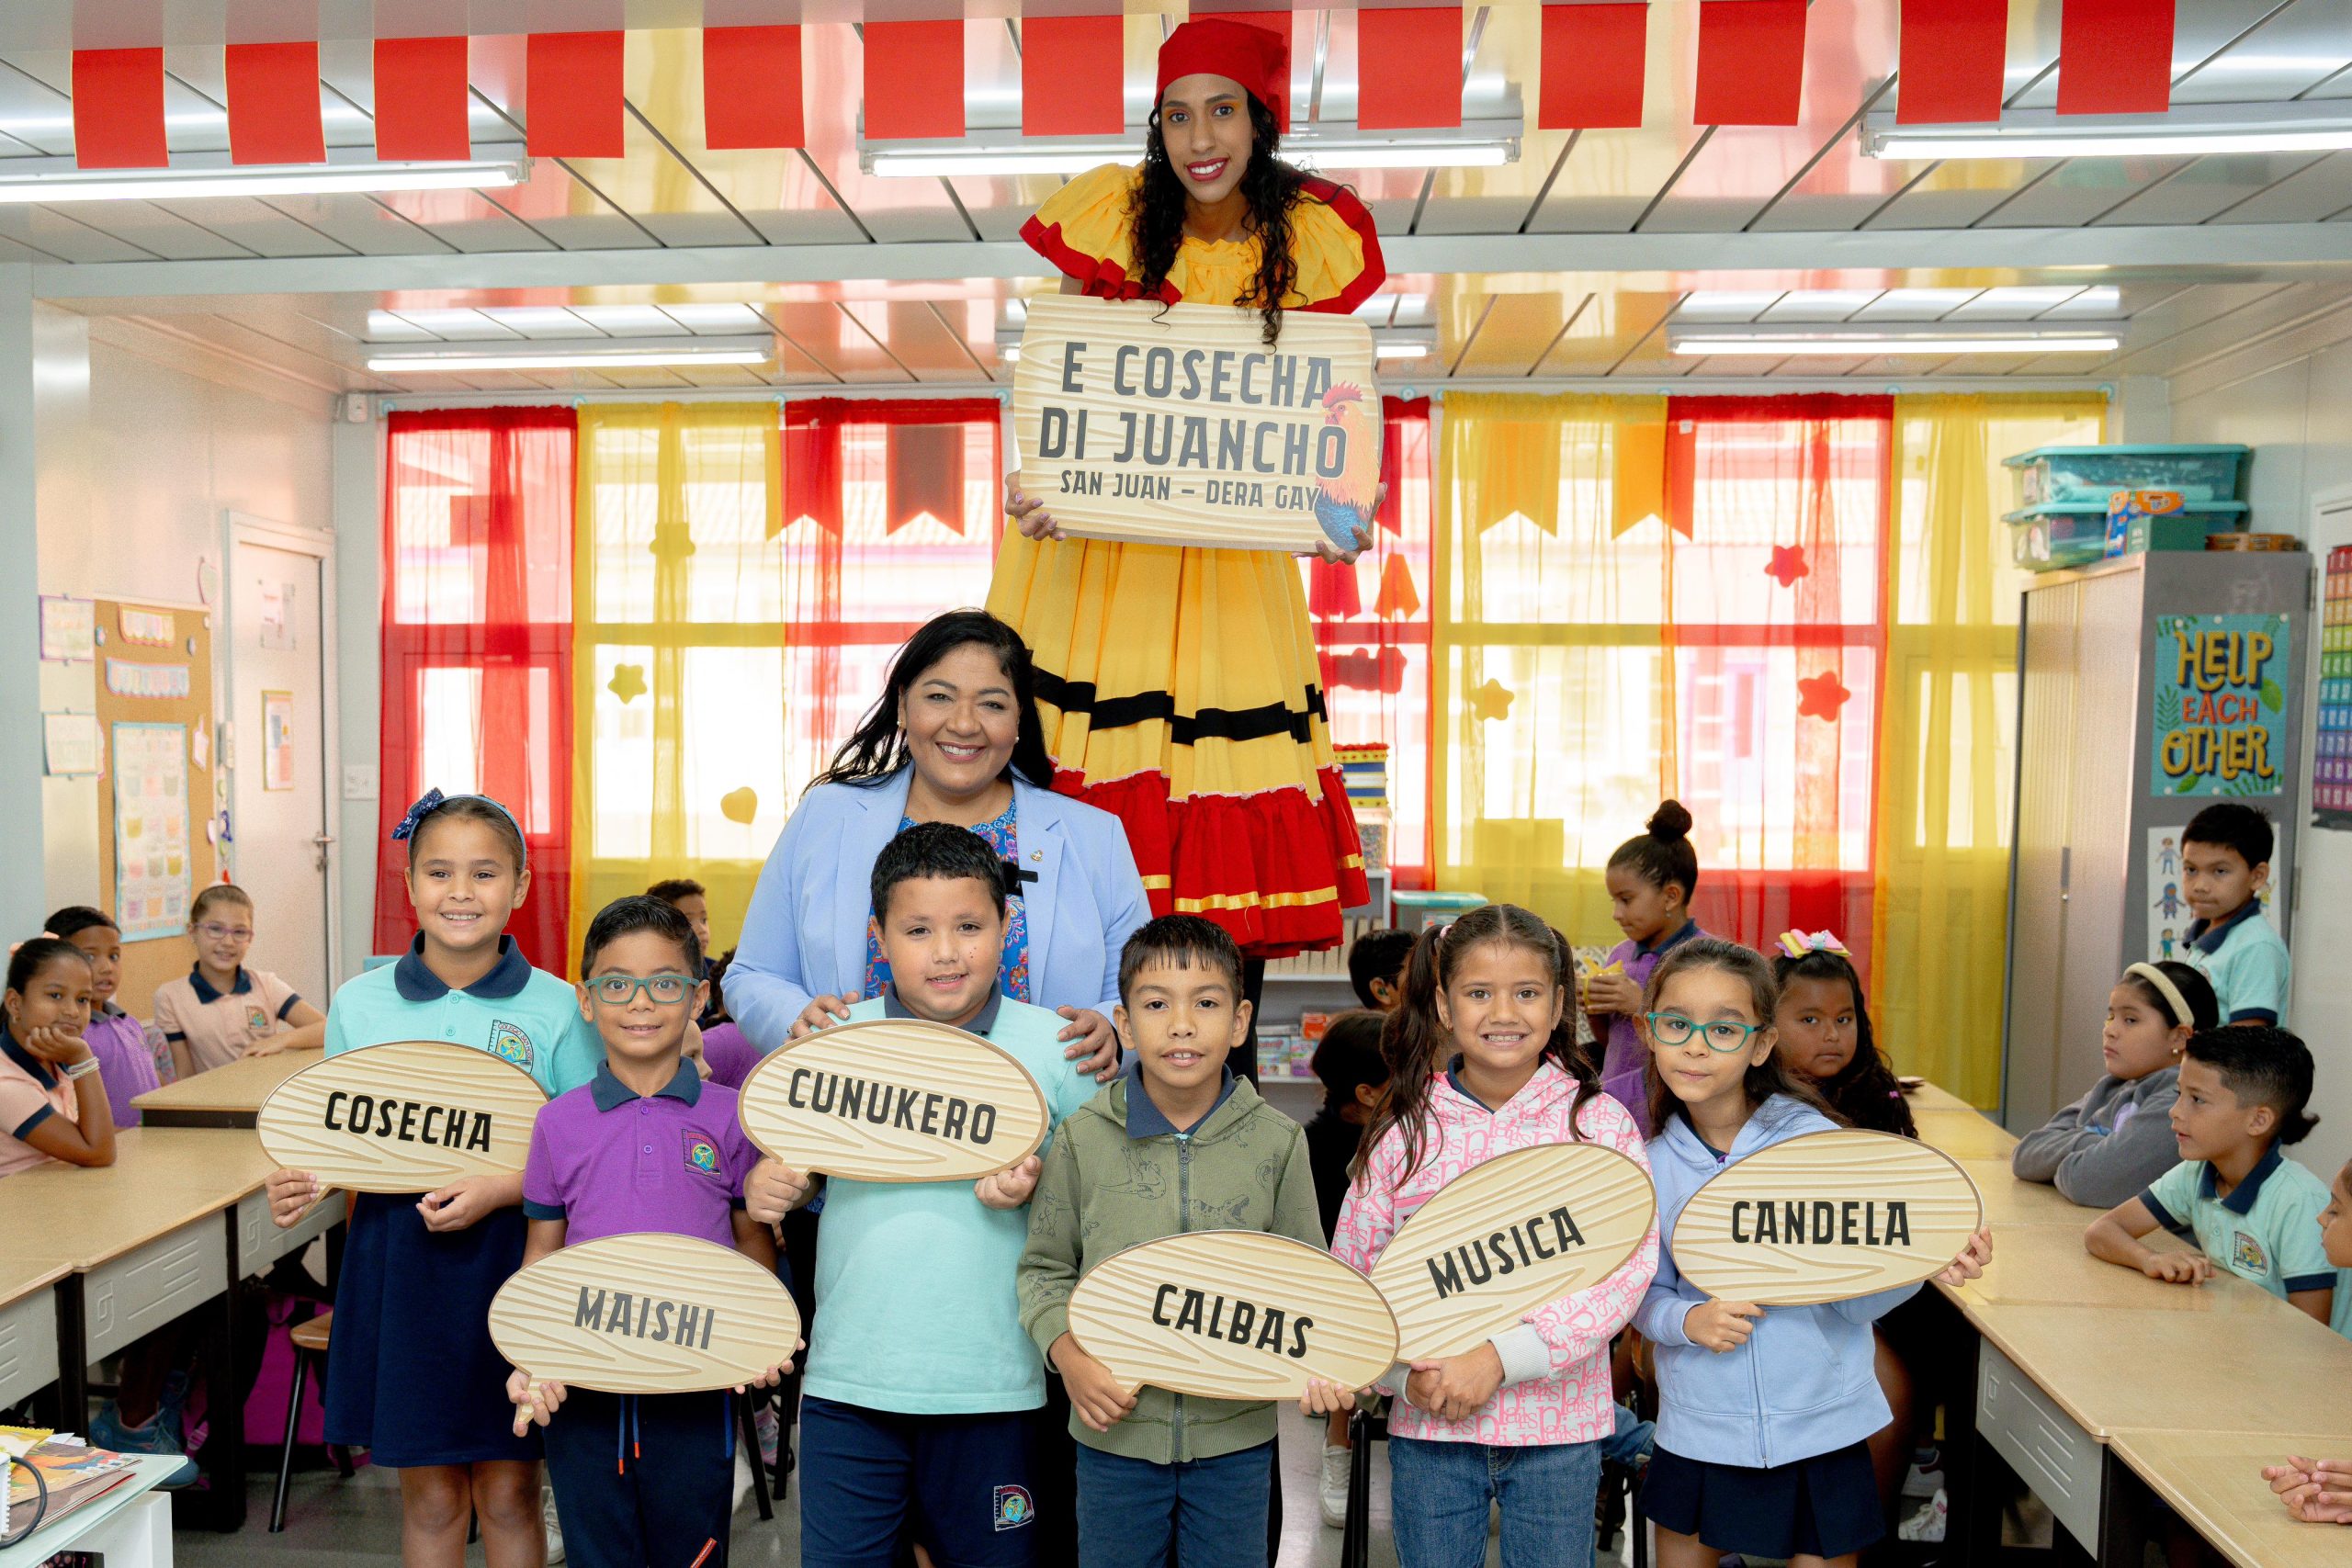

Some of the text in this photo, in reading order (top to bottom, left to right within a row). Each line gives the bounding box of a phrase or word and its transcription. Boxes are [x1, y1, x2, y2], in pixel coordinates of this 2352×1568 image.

[1062, 342, 1332, 409] E COSECHA
[1039, 406, 1347, 479] DI JUANCHO
[1059, 469, 1103, 496] SAN
[1112, 473, 1171, 501] JUAN
[1205, 479, 1263, 508] DERA
[1275, 484, 1318, 512] GAY
[2173, 630, 2274, 692] HELP
[2182, 692, 2258, 725] EACH
[2161, 724, 2275, 780] OTHER
[324, 1090, 492, 1153] COSECHA
[788, 1067, 997, 1145] CUNUKERO
[1426, 1205, 1586, 1300] MUSICA
[1732, 1200, 1911, 1247] CANDELA
[574, 1286, 715, 1350] MAISHI
[1151, 1283, 1314, 1359] CALBAS
